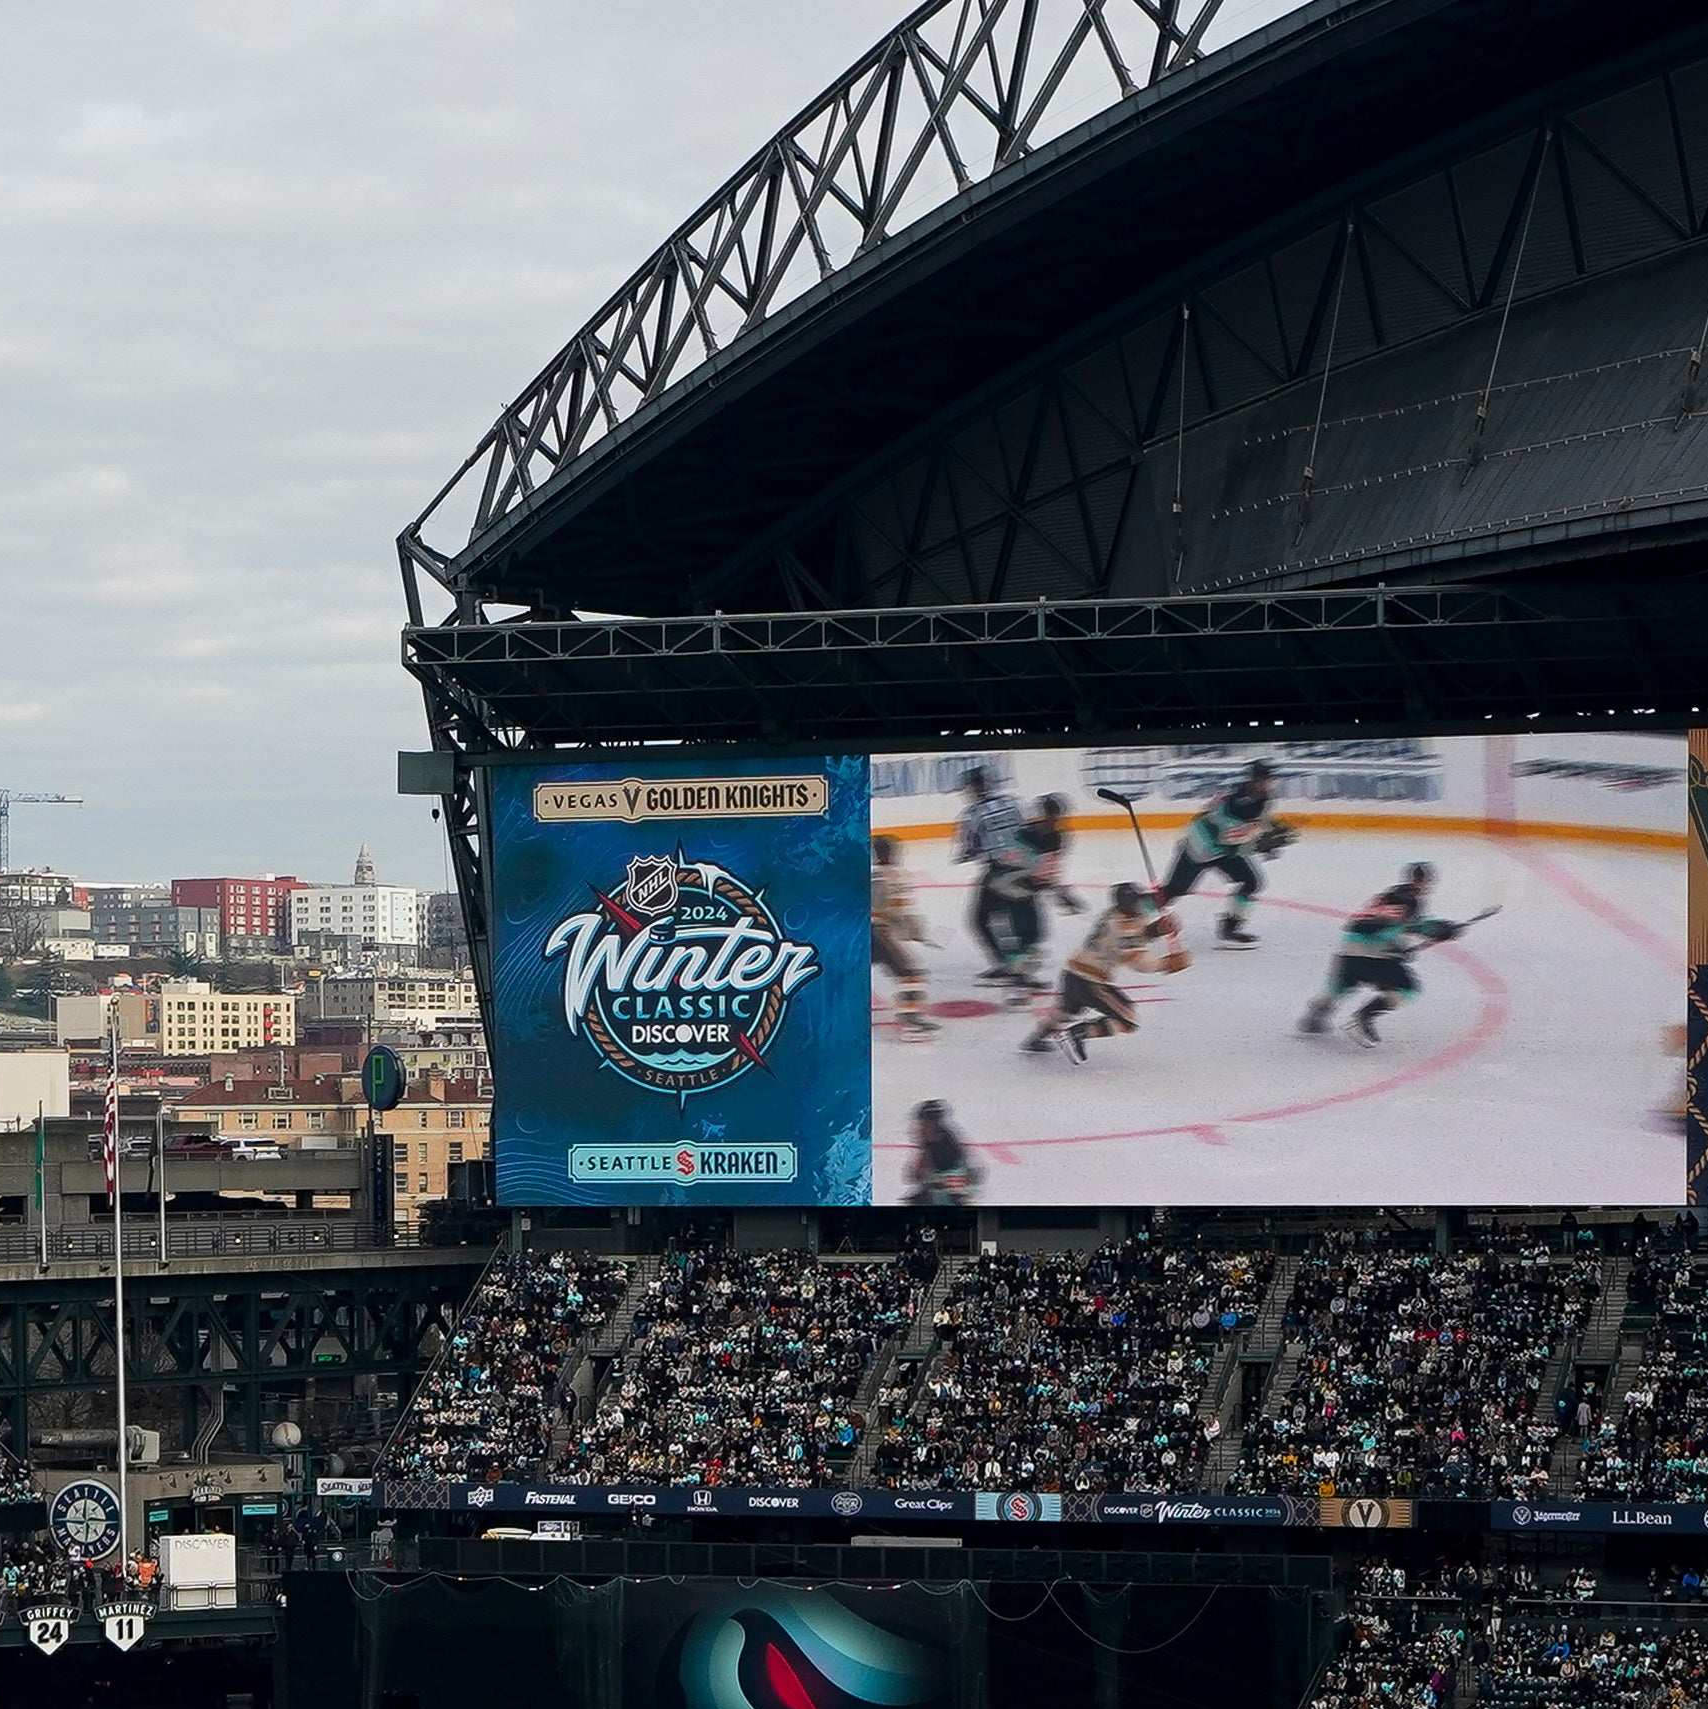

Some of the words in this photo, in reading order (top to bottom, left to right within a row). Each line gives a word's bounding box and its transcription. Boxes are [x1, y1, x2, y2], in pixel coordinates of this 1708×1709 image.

[553, 793, 618, 809] VEGAS
[646, 786, 720, 810] GOLDEN
[725, 783, 810, 809] KNIGHTS
[638, 867, 670, 905] NHL
[680, 905, 729, 922] 2024
[546, 913, 819, 1036] Winter
[612, 995, 752, 1021] CLASSIC
[632, 1023, 730, 1045] DISCOVER
[644, 1067, 720, 1087] SEATTLE
[587, 1154, 672, 1171] SEATTLE
[700, 1150, 778, 1175] KRAKEN
[525, 1491, 577, 1505] FASTENAL
[608, 1494, 656, 1506] GEICO
[749, 1497, 799, 1509] DISCOVER
[895, 1499, 925, 1510] Great
[927, 1500, 953, 1512] Clips
[1155, 1501, 1212, 1523] Winter
[1213, 1508, 1263, 1518] CLASSIC
[27, 1607, 74, 1620] GRIFFEY
[99, 1603, 154, 1617] MARTINEZ
[37, 1621, 63, 1643] 24
[115, 1618, 135, 1640] 11
